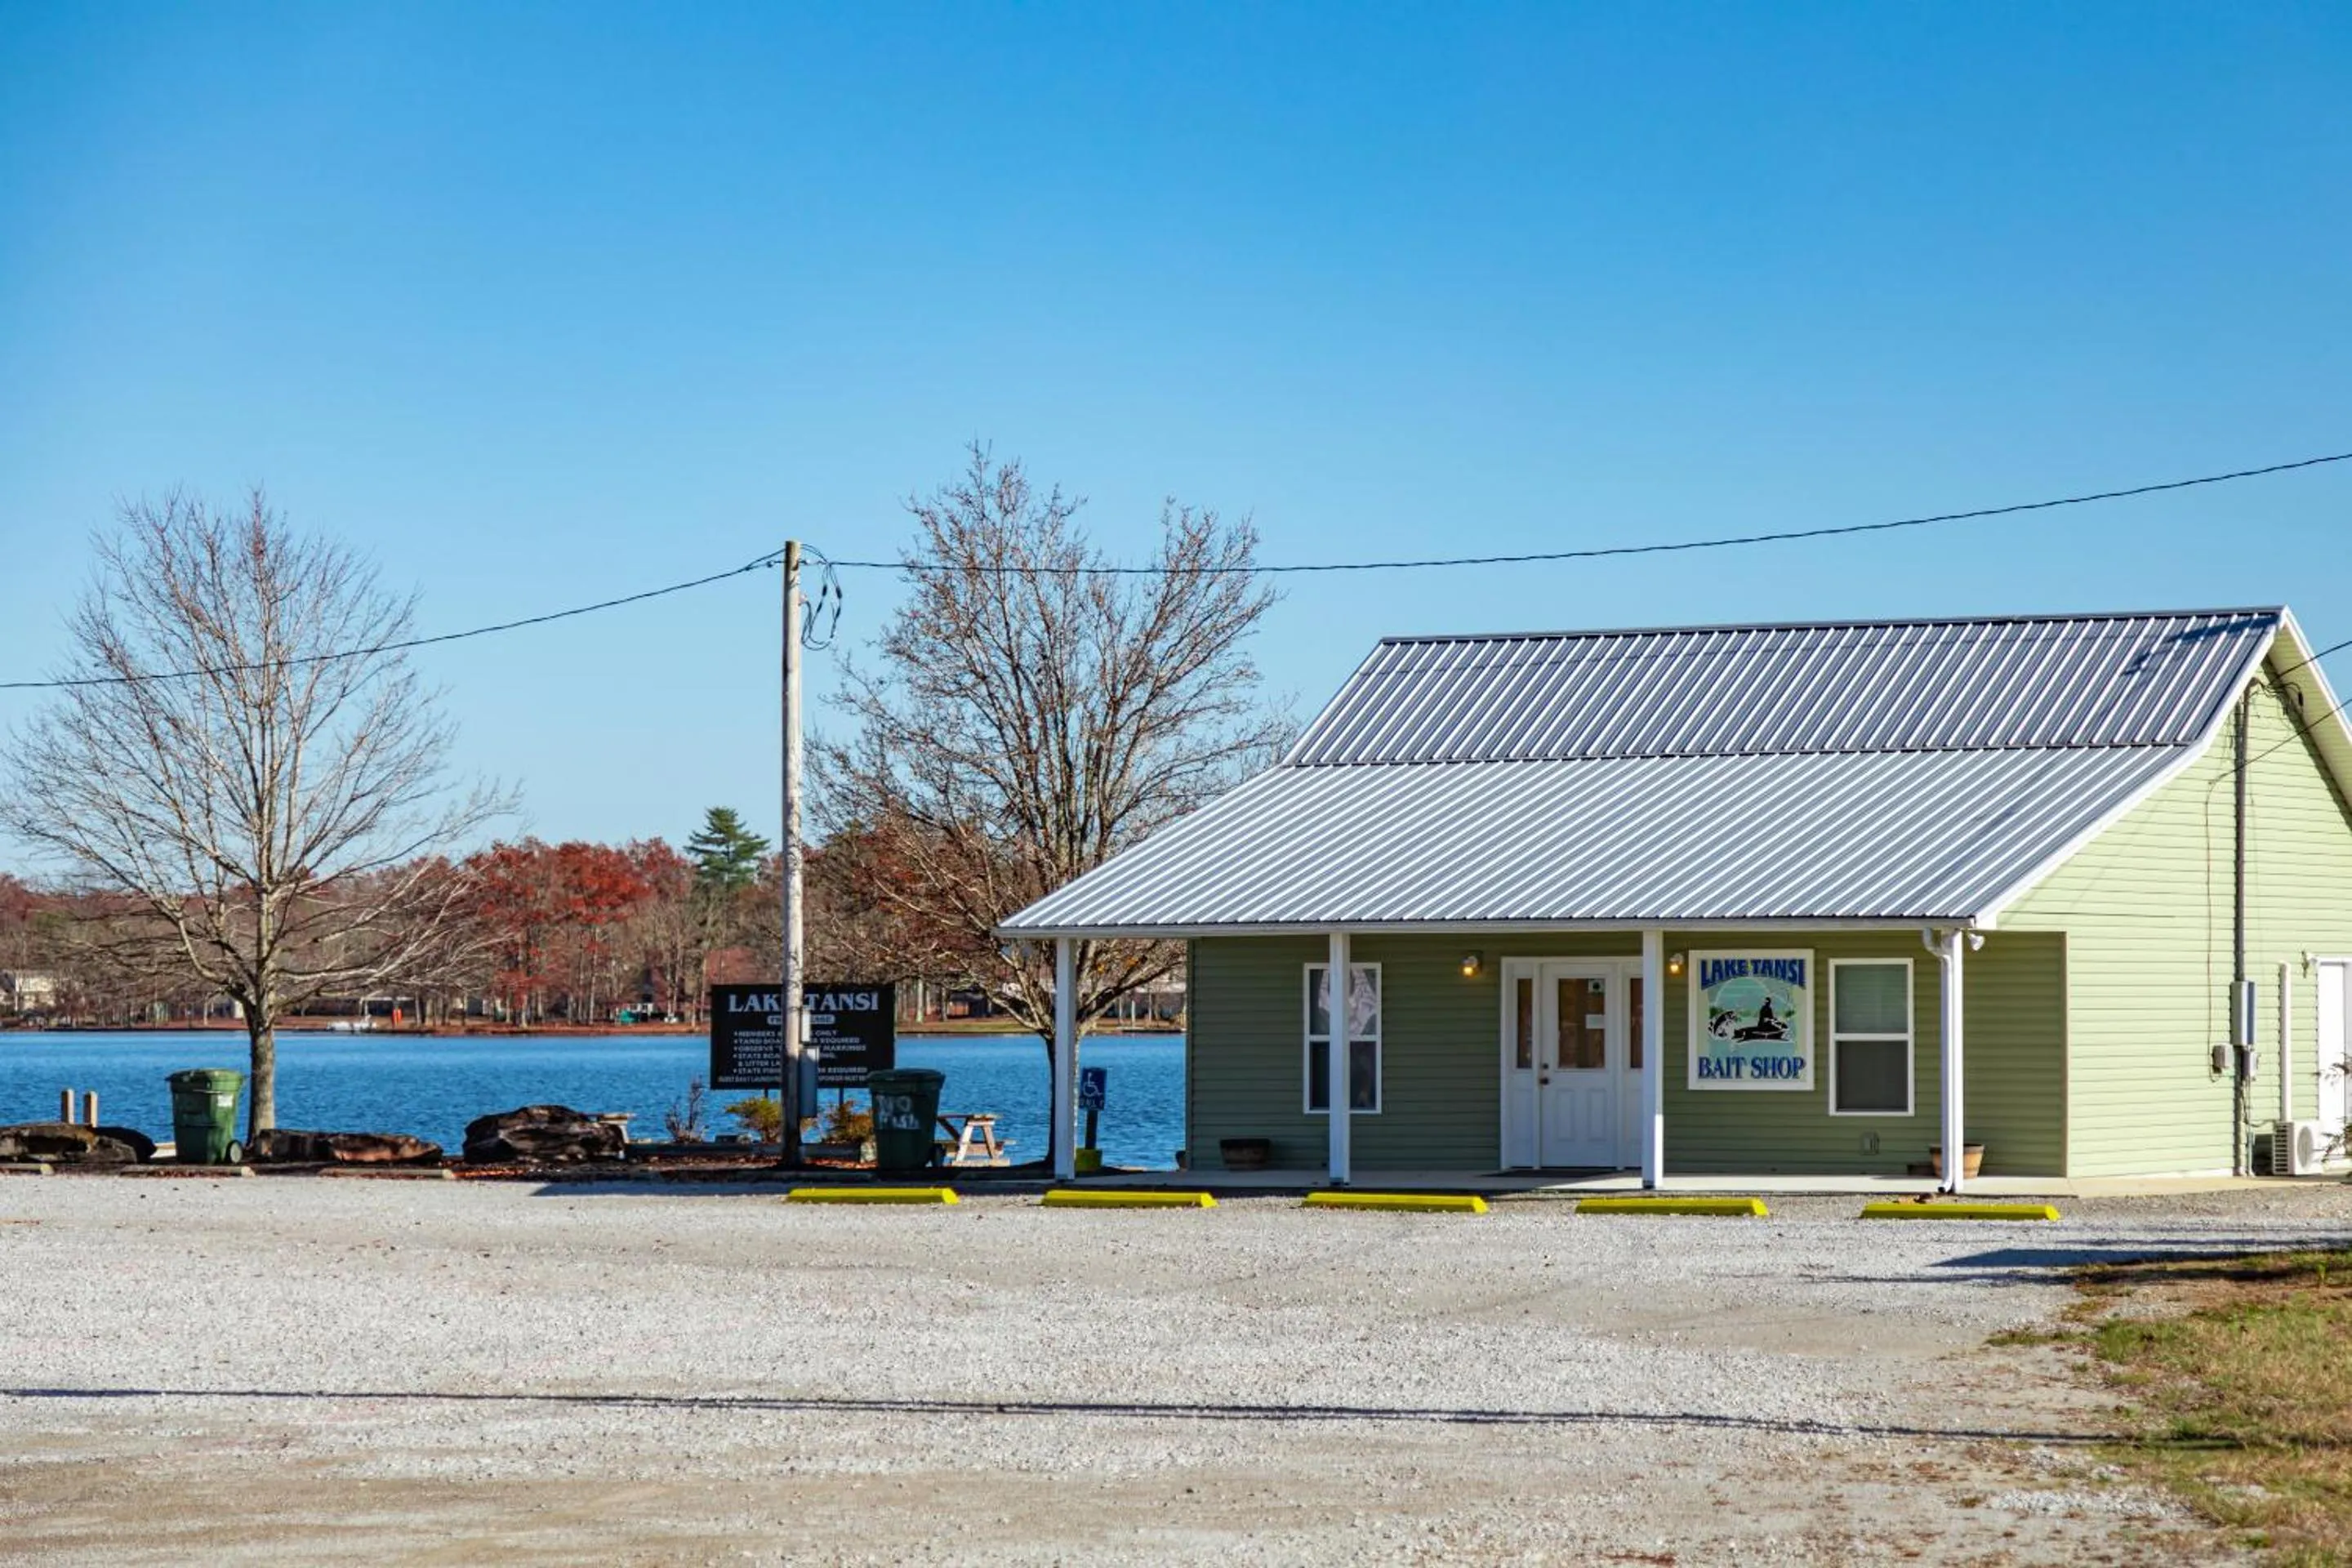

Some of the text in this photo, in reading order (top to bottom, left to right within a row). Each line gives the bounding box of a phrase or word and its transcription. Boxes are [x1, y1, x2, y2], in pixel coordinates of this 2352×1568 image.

[1700, 959, 1806, 990] LAKE TANSI
[728, 992, 879, 1013] LAK TANSI
[1698, 1055, 1806, 1080] BAIT SHOP
